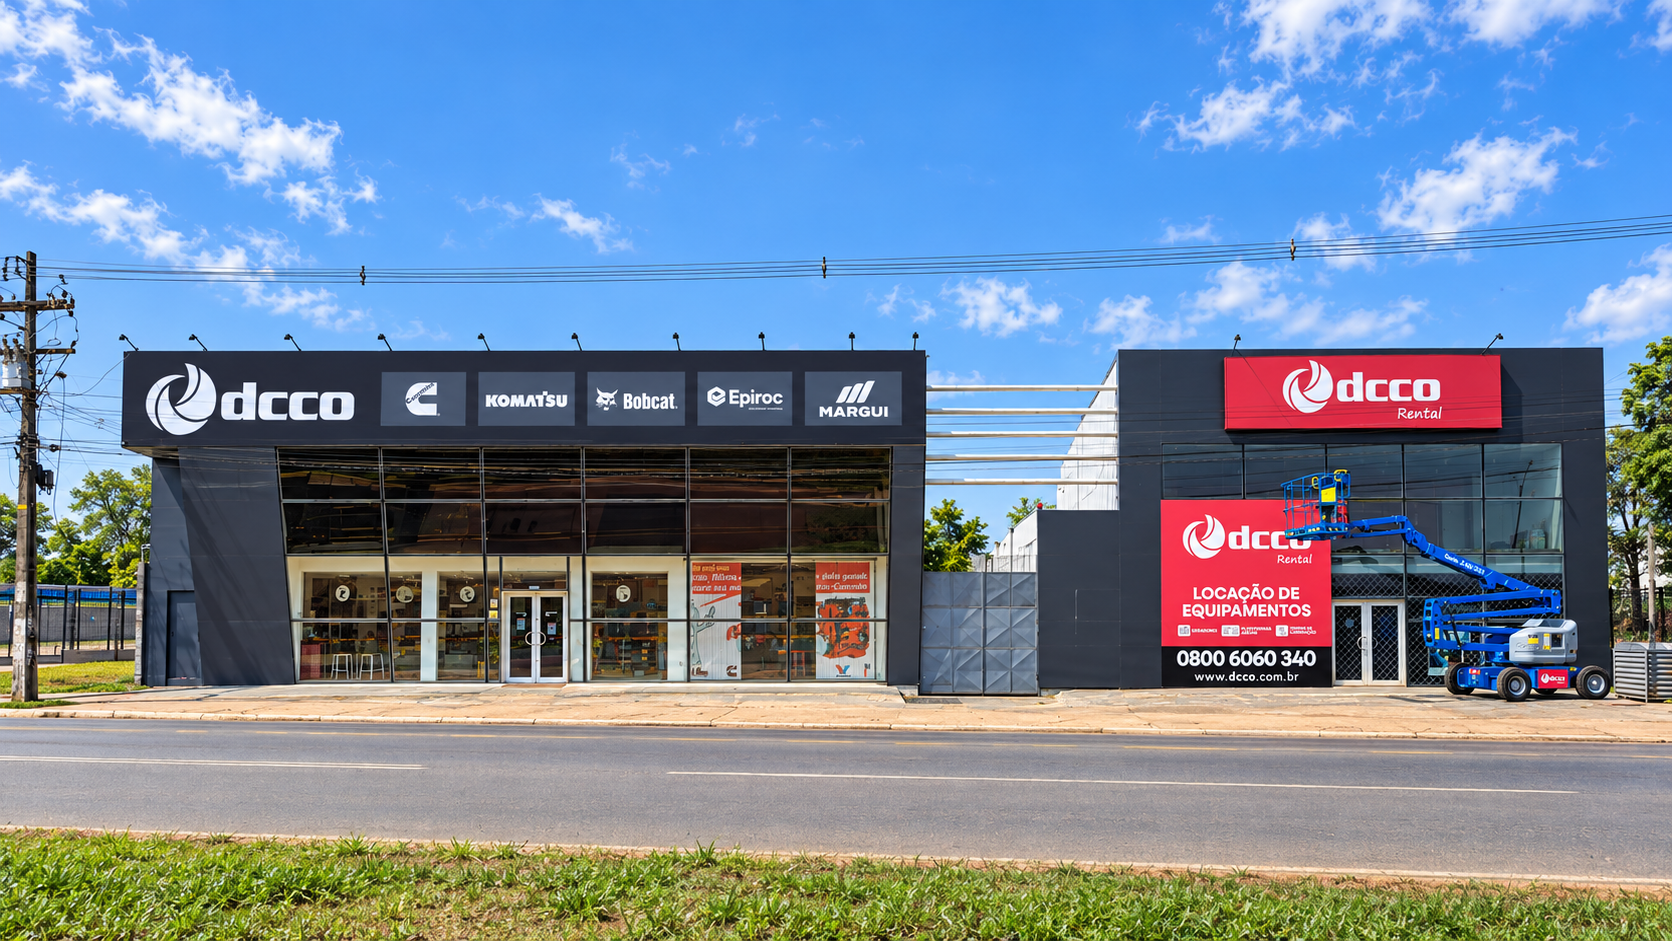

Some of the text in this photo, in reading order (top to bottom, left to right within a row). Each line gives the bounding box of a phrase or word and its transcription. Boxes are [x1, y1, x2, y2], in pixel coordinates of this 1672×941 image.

[1337, 371, 1441, 402] dcco
[220, 382, 355, 421] dcco
[485, 391, 568, 408] KOMATSU
[728, 389, 784, 408] Epiroc
[819, 406, 889, 418] MARGUI
[1397, 406, 1442, 420] Rental
[1277, 554, 1313, 565] Rental
[1193, 583, 1300, 603] LOCAÇÃO DE
[1182, 604, 1312, 619] EQUIPAMENTOS
[1176, 650, 1317, 667] 0800 6060 340
[1194, 671, 1299, 682] www.dcco.com.br
